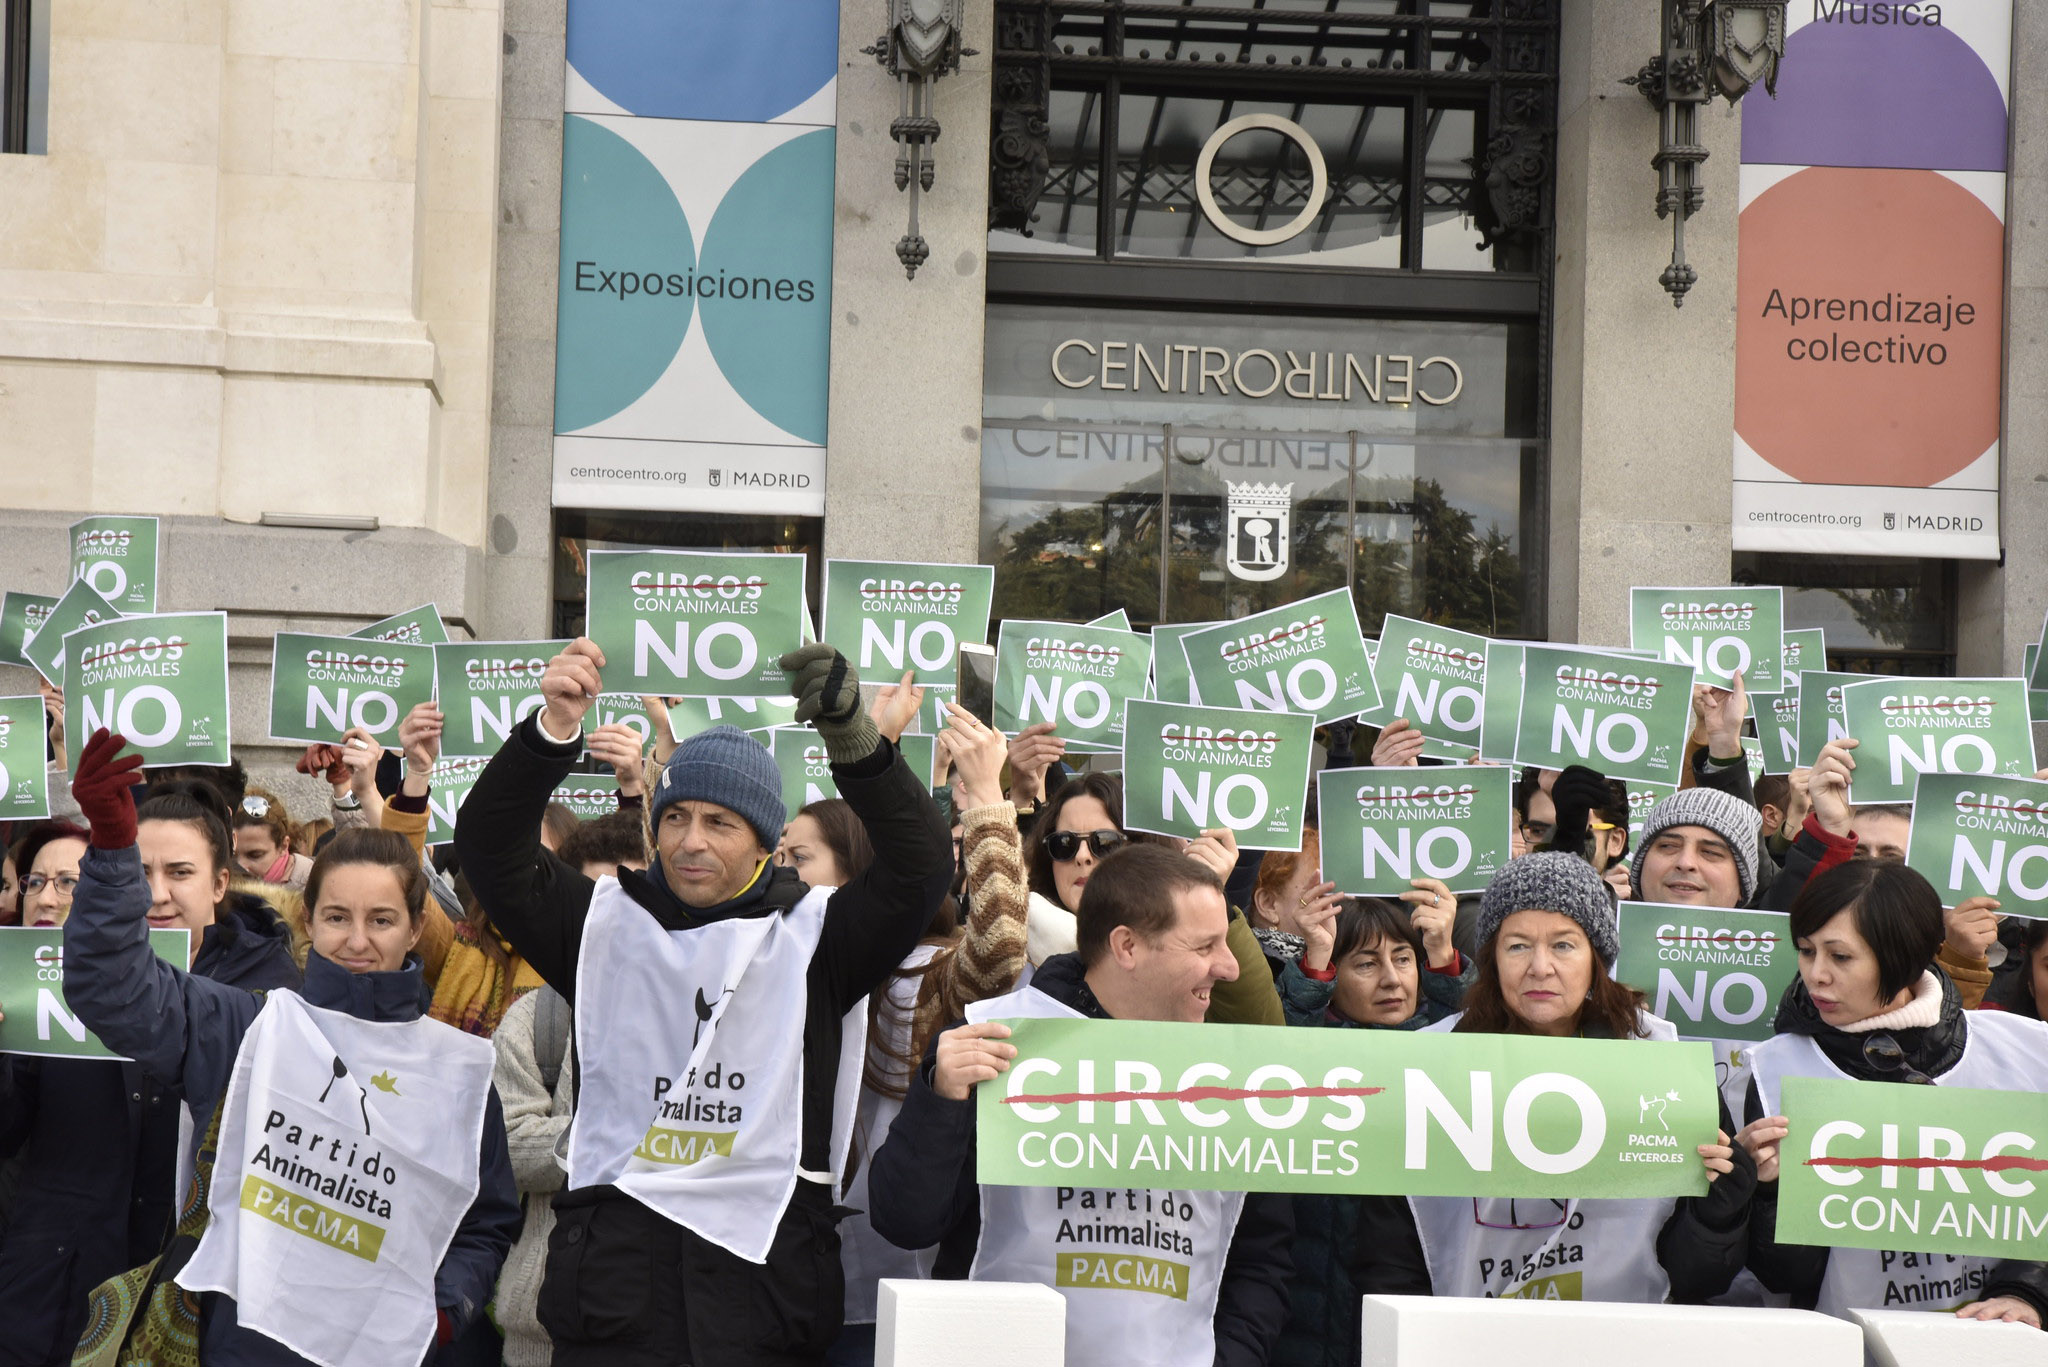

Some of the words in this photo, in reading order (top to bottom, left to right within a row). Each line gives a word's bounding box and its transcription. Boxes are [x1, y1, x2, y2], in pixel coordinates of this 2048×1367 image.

[575, 261, 815, 302] Exposiciones
[1762, 288, 1975, 332] Aprendizaje
[1786, 332, 1948, 365] colectivo
[570, 466, 687, 484] centrocentro.org
[733, 471, 811, 488] MADRID
[1748, 510, 1862, 528] centrocentro.org
[1907, 515, 1983, 531] MADRID
[631, 571, 762, 599] CIRCOS
[860, 578, 961, 602] CIRCOS
[634, 597, 670, 612] CON
[675, 600, 758, 614] ANIMALES
[862, 600, 891, 612] CON
[894, 602, 958, 615] ANIMALES
[1660, 602, 1753, 620] CIRCOS
[1220, 615, 1324, 662] CIRCOS
[1663, 620, 1689, 631] CON
[1692, 620, 1751, 631] ANIMALES
[80, 635, 183, 671] CIRCOS
[634, 619, 758, 680] NO
[860, 618, 955, 671] NO
[1026, 637, 1120, 666] CIRCOS
[1228, 658, 1258, 674] CON
[1261, 636, 1326, 666] ANIMALES
[1664, 635, 1751, 680] NO
[82, 671, 103, 687] CON
[105, 662, 180, 684] ANIMALES
[306, 650, 405, 676] CIRCOS
[307, 668, 336, 681] CON
[338, 671, 401, 688] ANIMALES
[1026, 657, 1050, 669] CON
[1053, 661, 1115, 678] ANIMALES
[1405, 656, 1431, 671] CON
[468, 678, 495, 691] CON
[1234, 658, 1337, 712] NO
[1556, 664, 1658, 698] CIRCOS
[305, 685, 398, 735] NO
[1019, 674, 1111, 729] NO
[1394, 671, 1484, 732] NO
[1556, 685, 1583, 700] CON
[1585, 690, 1653, 710] ANIMALES
[1880, 695, 1993, 716] CIRCOS
[82, 684, 182, 749] NO
[1776, 714, 1795, 723] CON
[1885, 716, 1918, 728] CON
[1920, 716, 1991, 729] ANIMALES
[1161, 723, 1277, 754] CIRCOS
[1551, 703, 1649, 763] NO
[1162, 747, 1195, 762] CON
[1199, 751, 1271, 768] ANIMALES
[1888, 734, 1997, 786] NO
[1162, 767, 1269, 830] NO
[1356, 784, 1473, 807] CIRCOS
[1360, 807, 1393, 820] CON
[1396, 806, 1471, 820] ANIMALES
[1956, 814, 1990, 830] CON
[1362, 826, 1472, 880] NO
[1949, 834, 2048, 901] NO
[1656, 924, 1776, 953] CIRCOS
[1658, 947, 1695, 961] CON
[1695, 952, 1771, 967] ANIMALES
[1654, 967, 1768, 1025] NO
[1006, 1057, 1366, 1132] CIRCOS
[1404, 1068, 1607, 1175] NO
[263, 1109, 397, 1186] Partido
[1017, 1131, 1118, 1170] CON
[1129, 1133, 1360, 1177] ANIMALES
[1628, 1134, 1678, 1147] PACMA
[1619, 1151, 1684, 1164] LEYCERO.ES
[251, 1143, 392, 1220] Animalista
[253, 1185, 360, 1250] PACMA
[1057, 1186, 1194, 1222] Partido
[1819, 1193, 1921, 1234] CON
[1055, 1217, 1193, 1257] Animalista
[1071, 1257, 1177, 1293] PACMA
